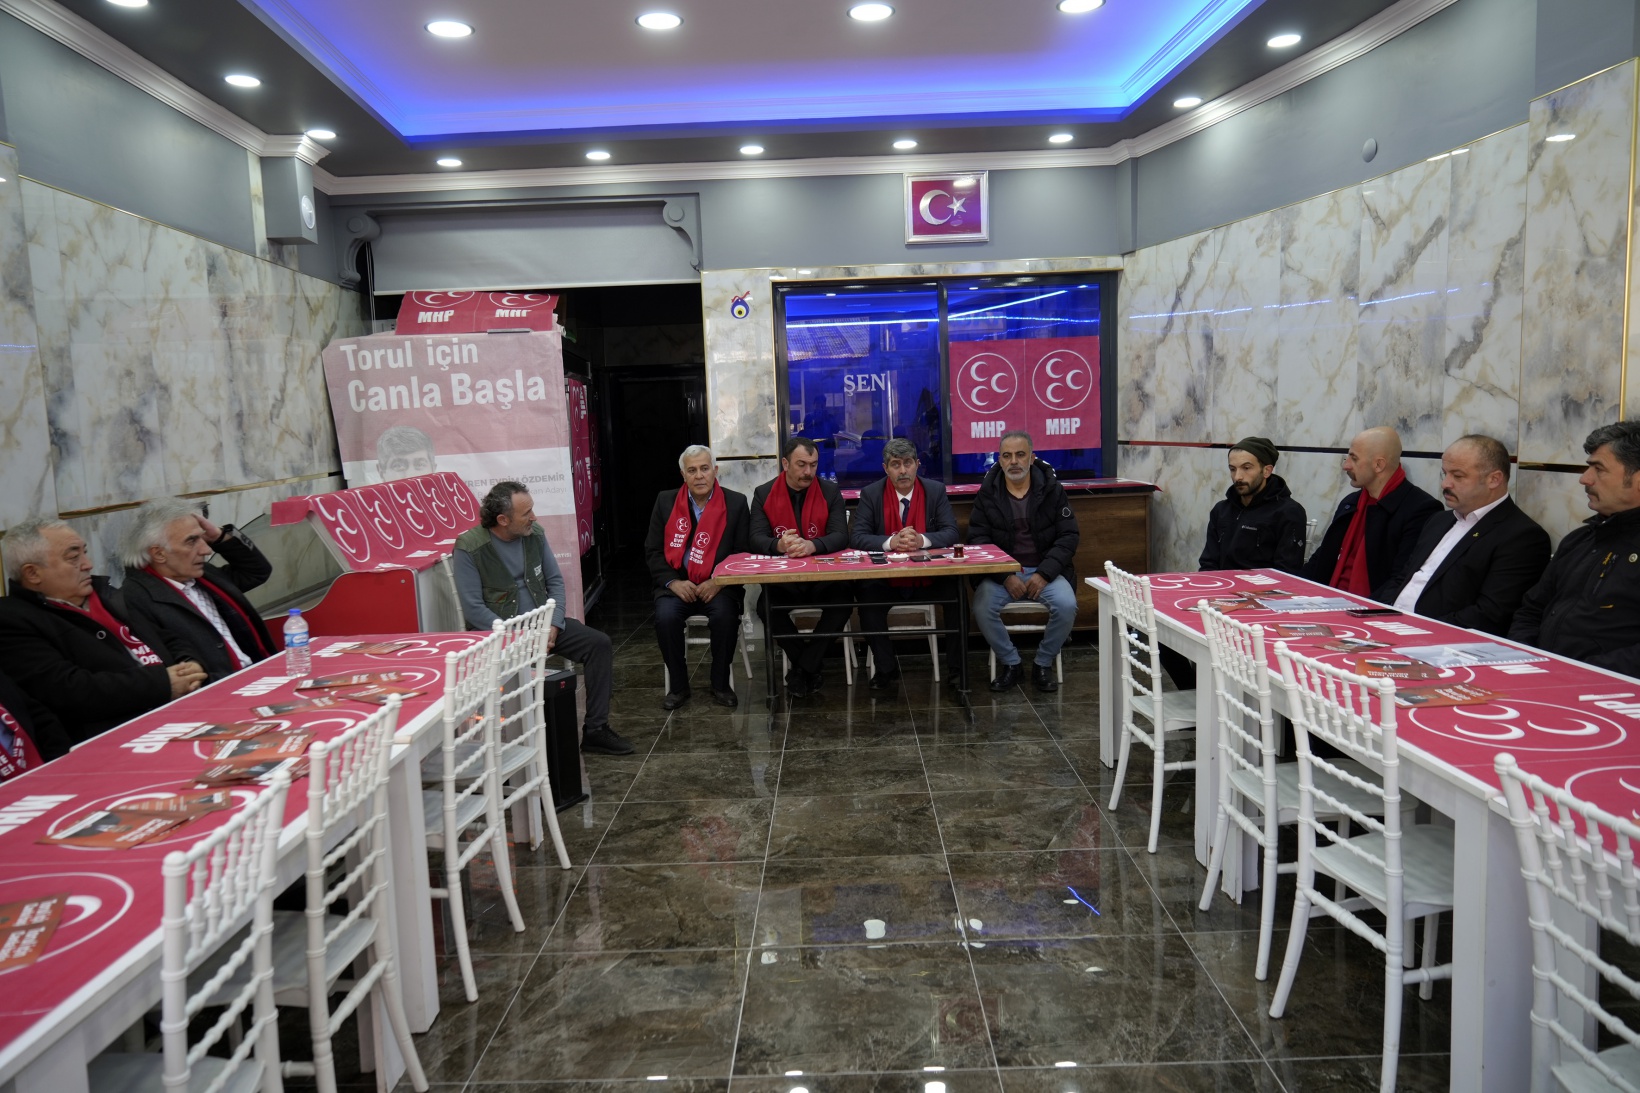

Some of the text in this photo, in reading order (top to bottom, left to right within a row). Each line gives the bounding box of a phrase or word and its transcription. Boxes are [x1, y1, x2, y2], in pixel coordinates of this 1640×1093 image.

[418, 309, 455, 323] MHP
[340, 338, 479, 371] Torul için
[347, 369, 546, 412] Canla Başla
[843, 373, 886, 397] ŞEN
[971, 421, 1006, 438] MHP
[1045, 418, 1081, 435] MHP
[231, 676, 293, 696] MHP
[119, 721, 208, 753] MHP
